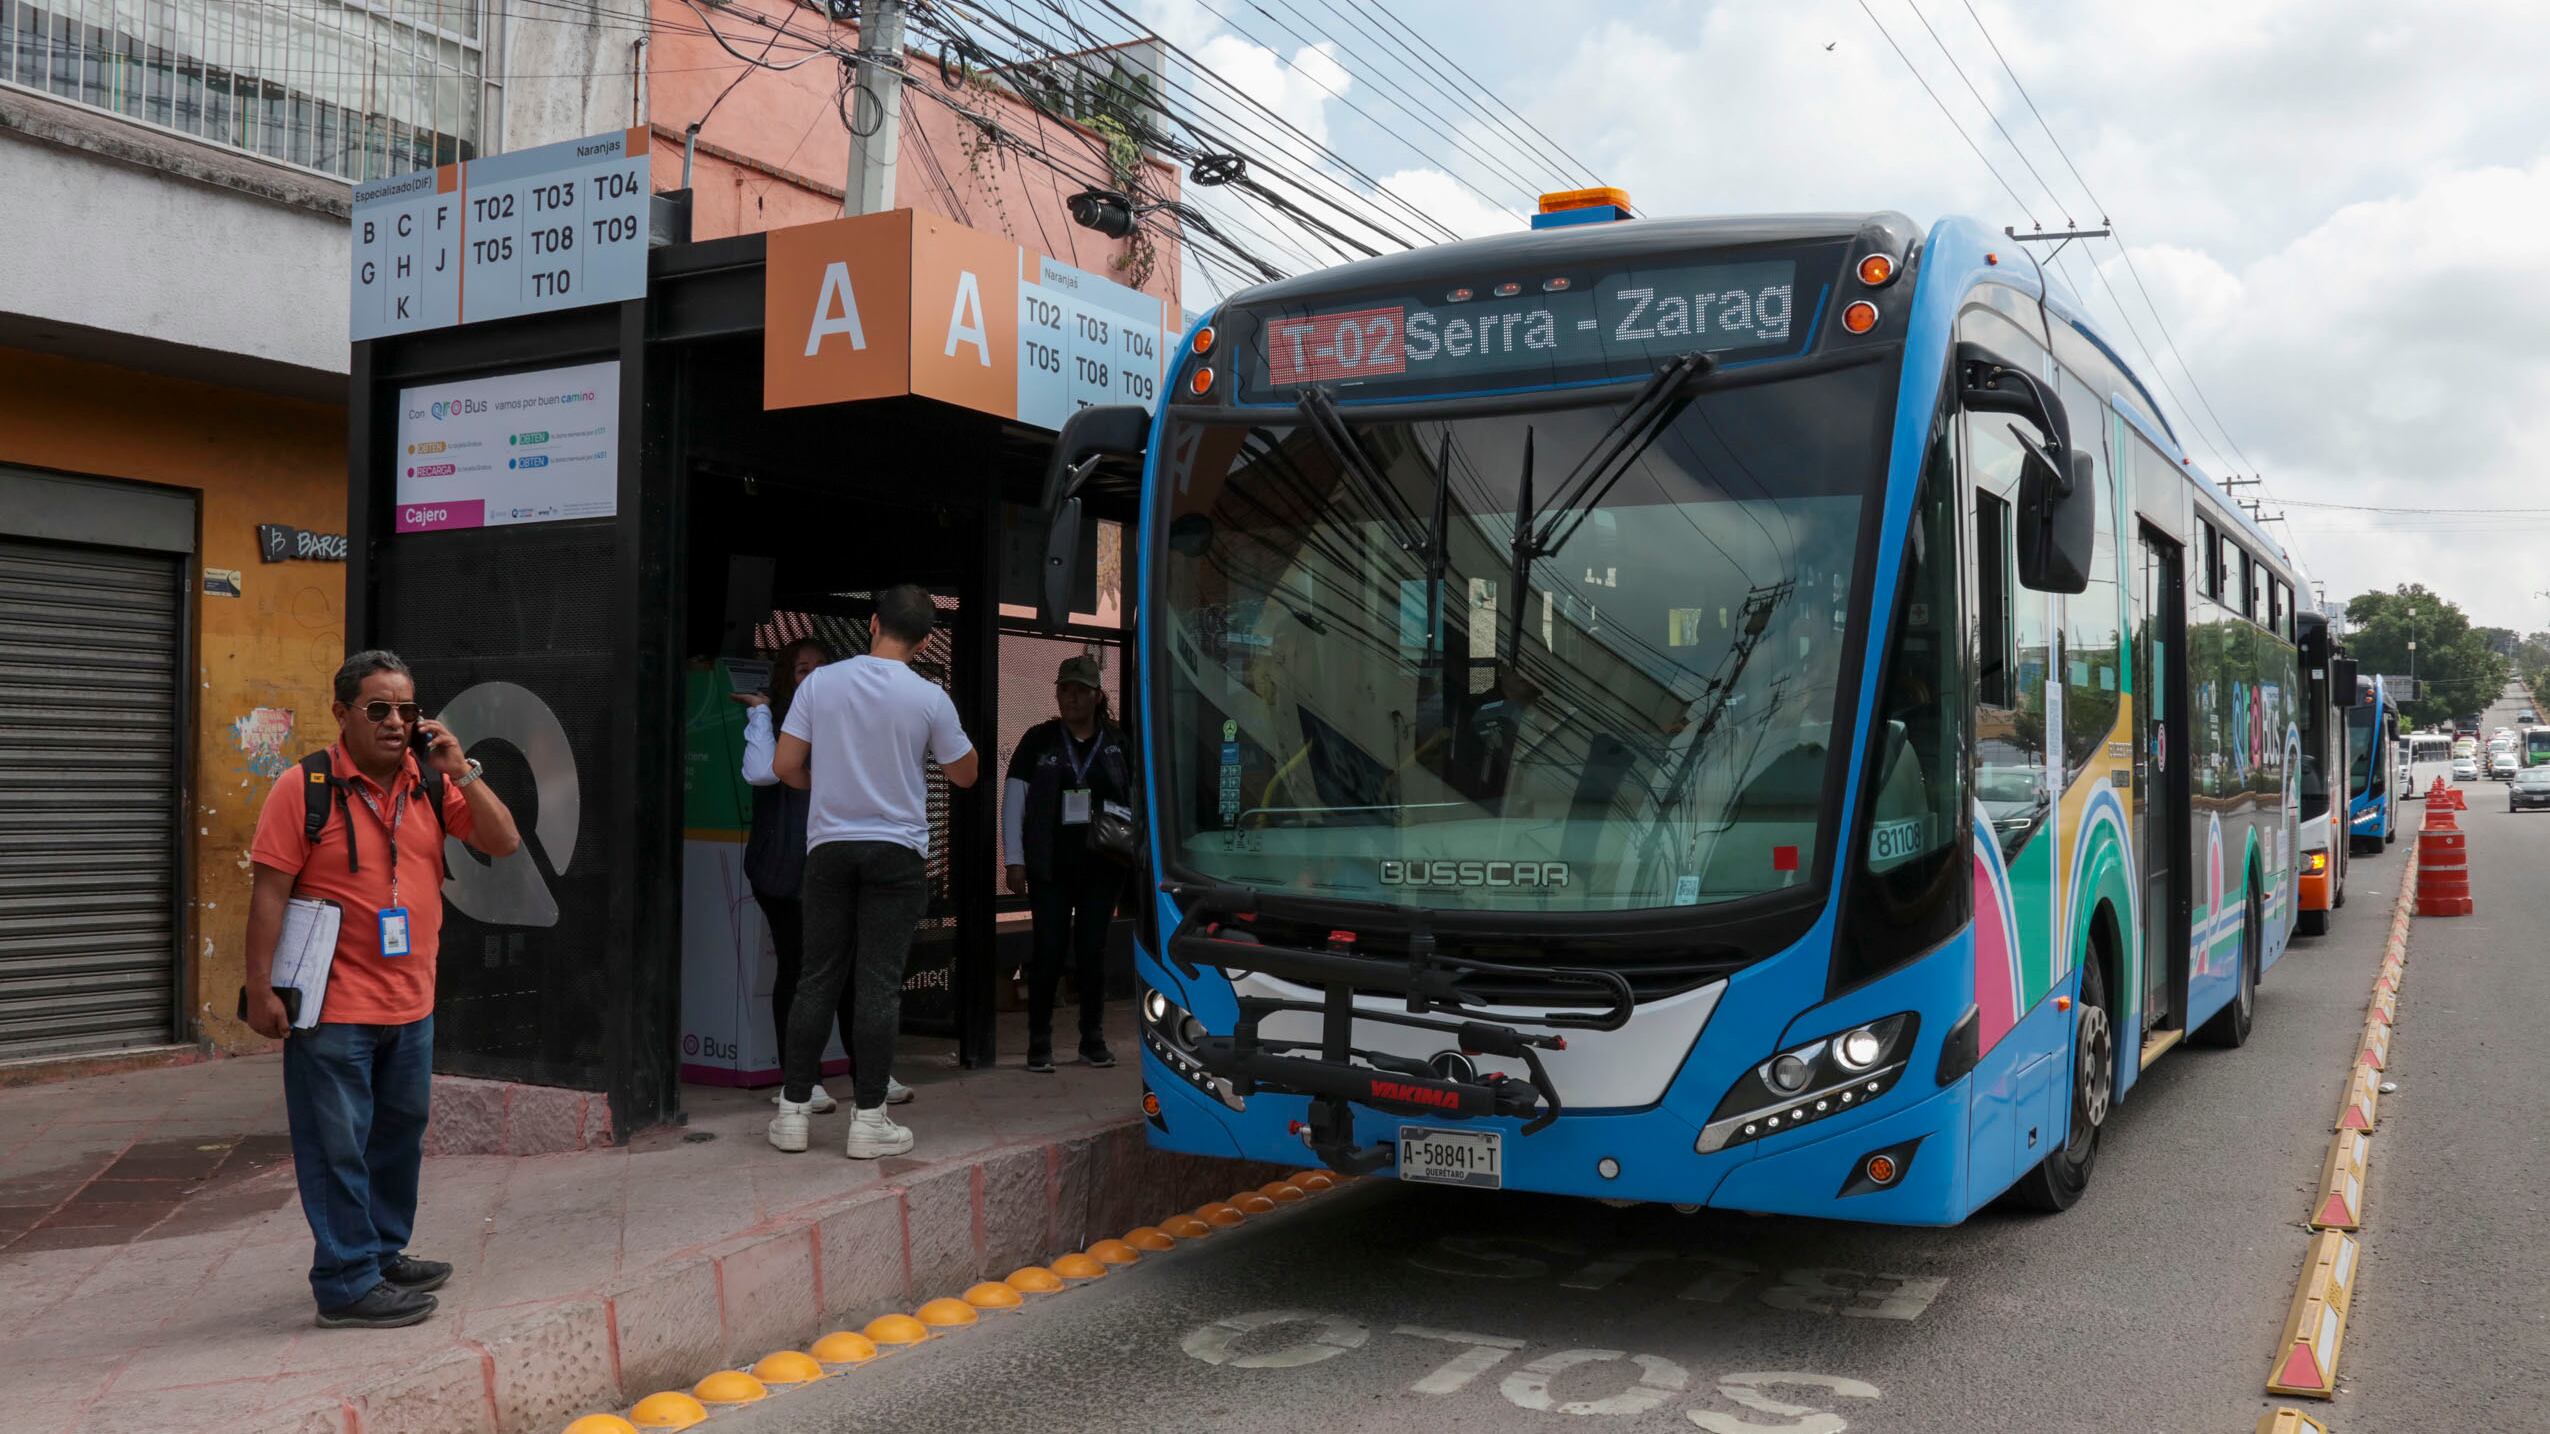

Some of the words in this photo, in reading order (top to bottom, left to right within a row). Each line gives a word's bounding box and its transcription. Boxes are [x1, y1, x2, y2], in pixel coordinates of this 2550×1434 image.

[577, 139, 620, 158] Naranjas
[474, 194, 514, 223] T02
[533, 182, 574, 212] T03
[594, 171, 639, 201] T04
[363, 221, 375, 244] B
[397, 214, 412, 237] C
[437, 206, 447, 230] F
[474, 236, 513, 265] T05
[532, 226, 573, 254] T08
[593, 215, 637, 244] T09
[361, 262, 375, 284] G
[397, 255, 410, 278] H
[436, 248, 446, 272] J
[1044, 266, 1079, 290] Naranjas
[532, 269, 571, 297] T10
[397, 296, 410, 319] K
[804, 262, 866, 356] A
[944, 270, 991, 367] A
[1026, 296, 1061, 331] T02
[1076, 313, 1109, 345] T03
[1122, 328, 1154, 361] T04
[1282, 315, 1397, 374] T-02
[1404, 308, 1557, 361] Serra
[1616, 283, 1793, 342] Zarag
[1026, 340, 1060, 374] T05
[1076, 356, 1109, 388] T08
[1122, 370, 1154, 402] T09
[409, 409, 425, 420] Con
[464, 399, 488, 414] Bus
[495, 401, 521, 411] vamos
[523, 398, 537, 410] por
[538, 396, 560, 406] buen
[561, 391, 595, 404] camino
[417, 466, 452, 477] RECARGA
[519, 457, 545, 468] OBTEN
[405, 507, 448, 526] Cajero
[1877, 822, 1921, 857] 81108
[1379, 860, 1570, 887] BUSSCAR
[703, 1036, 737, 1060] Bus
[1371, 1080, 1460, 1111] YAKIMA
[1403, 1140, 1497, 1173] A-58841-T
[1426, 1167, 1465, 1179] QUERÉTARO
[1180, 1310, 1881, 1434] SOLO
